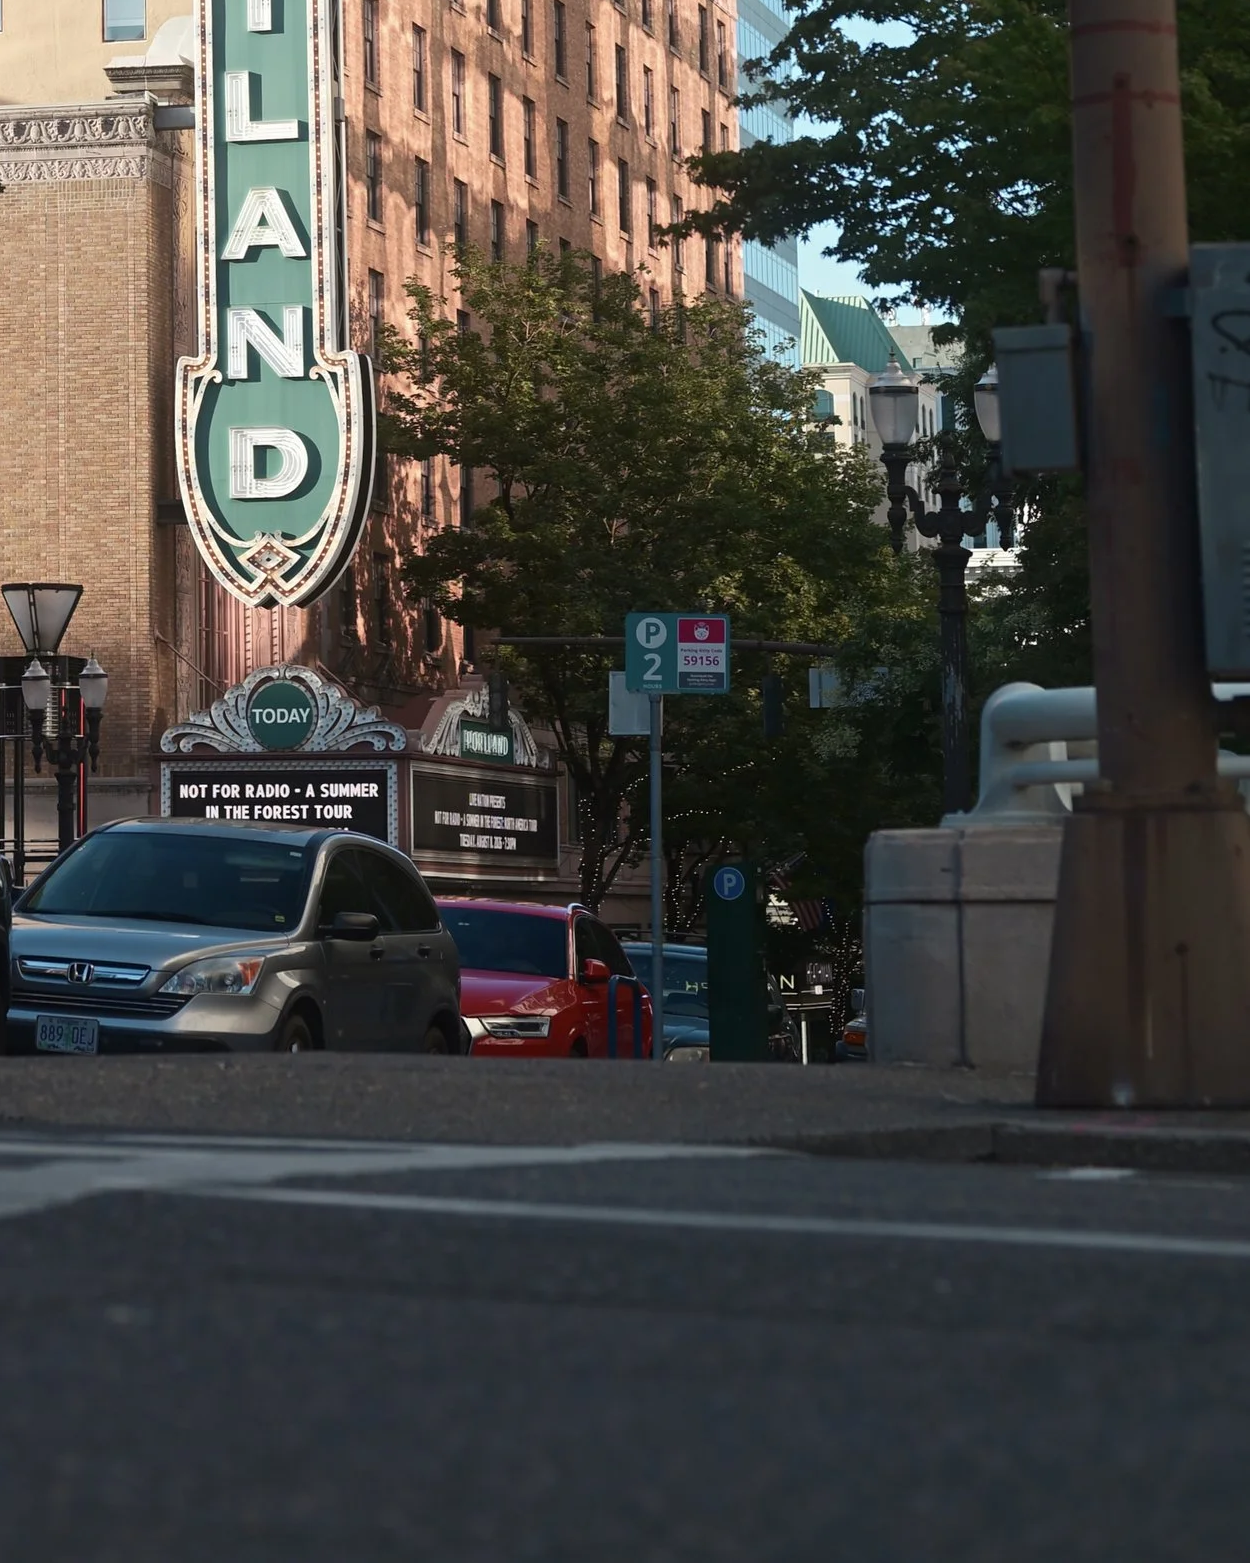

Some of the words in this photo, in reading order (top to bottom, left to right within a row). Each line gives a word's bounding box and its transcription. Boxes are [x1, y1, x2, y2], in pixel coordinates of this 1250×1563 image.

[645, 622, 661, 644] P
[643, 653, 662, 681] 2
[683, 655, 720, 666] 59156
[252, 708, 310, 724] TODAY
[463, 729, 509, 757] PORTLAND
[179, 784, 208, 799] NOT
[212, 784, 241, 799] FOR
[245, 784, 291, 798] RADIO
[305, 784, 316, 798] A
[320, 783, 379, 798] SUMMER
[205, 805, 219, 819] IN
[223, 805, 250, 820] THE
[253, 804, 310, 819] FOREST
[313, 804, 353, 819] TOUR
[724, 873, 737, 895] P
[40, 1023, 64, 1042] 889
